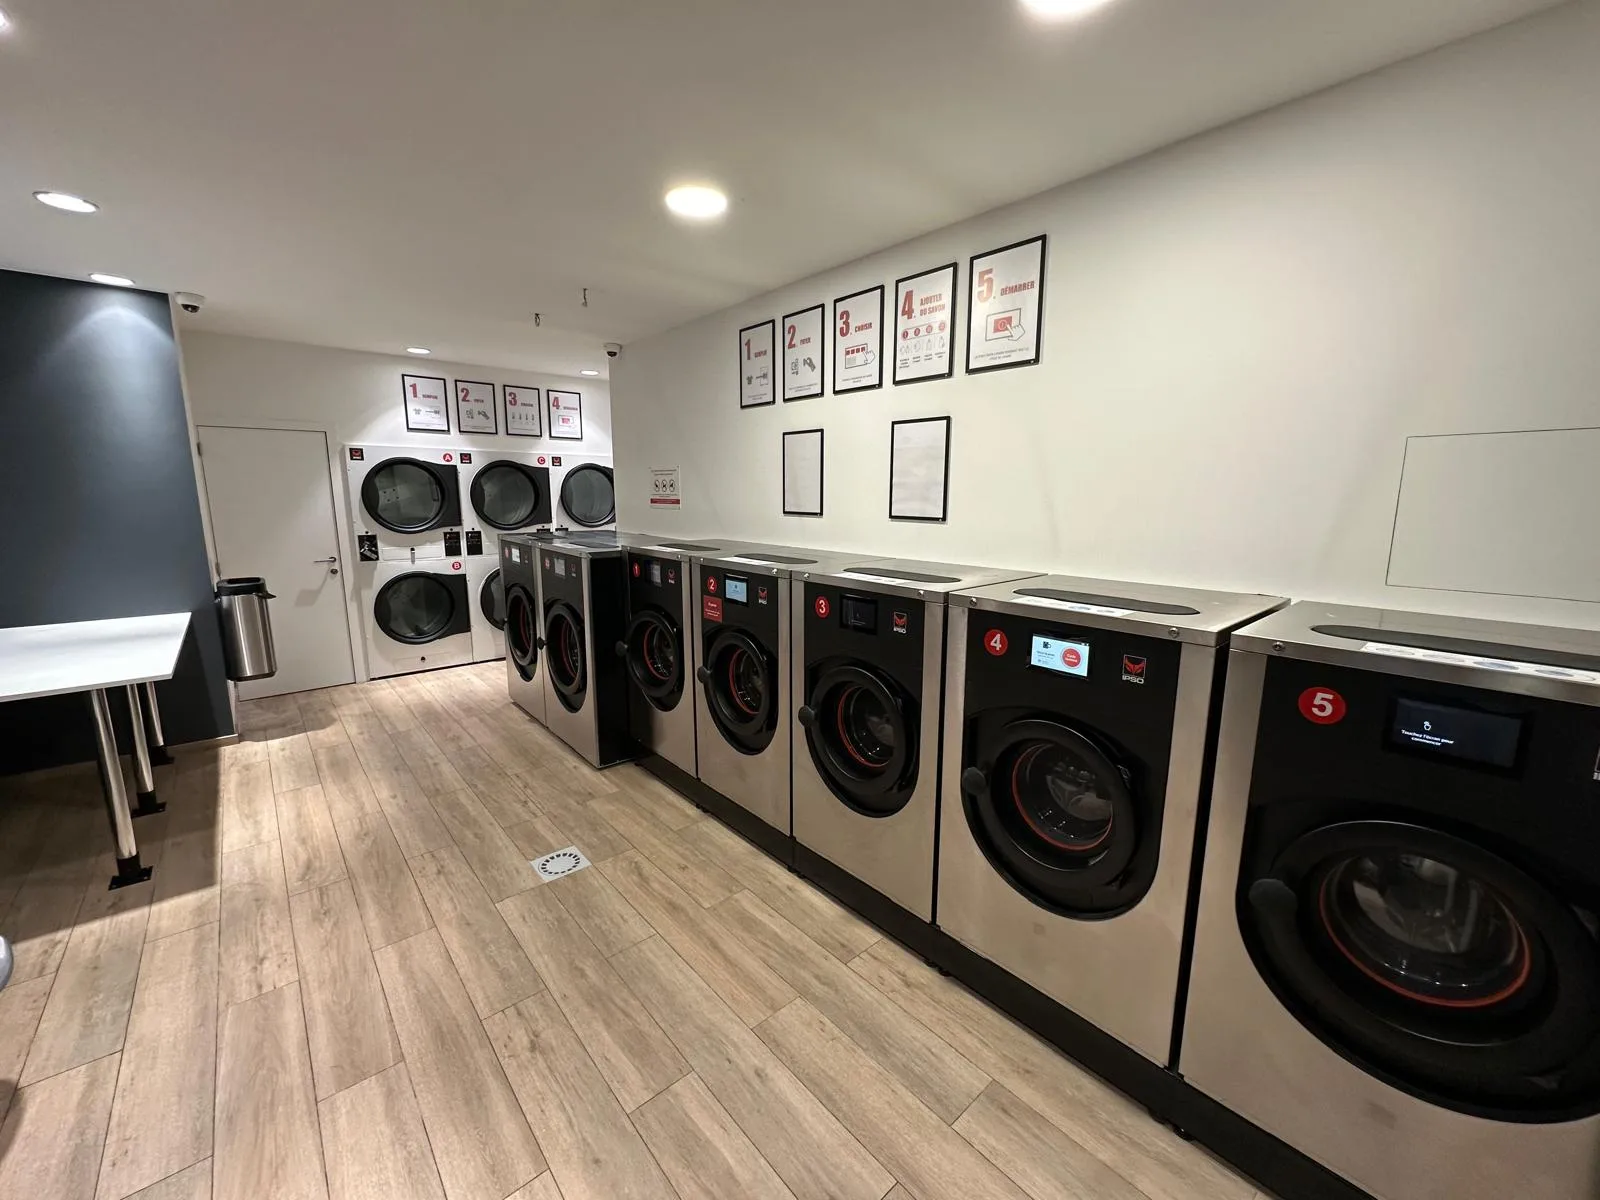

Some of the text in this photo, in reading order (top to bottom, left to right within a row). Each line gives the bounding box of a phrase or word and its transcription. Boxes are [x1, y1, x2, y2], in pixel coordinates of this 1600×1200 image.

[1000, 280, 1035, 297] DÉMARRER
[919, 293, 942, 306] AJOUTER
[927, 303, 946, 315] SAVON
[709, 578, 715, 591] 2
[819, 599, 826, 614] 3
[990, 633, 1002, 651] 4
[1122, 675, 1145, 684] IPSO
[1311, 692, 1334, 717] 5
[1401, 729, 1423, 738] Touchez
